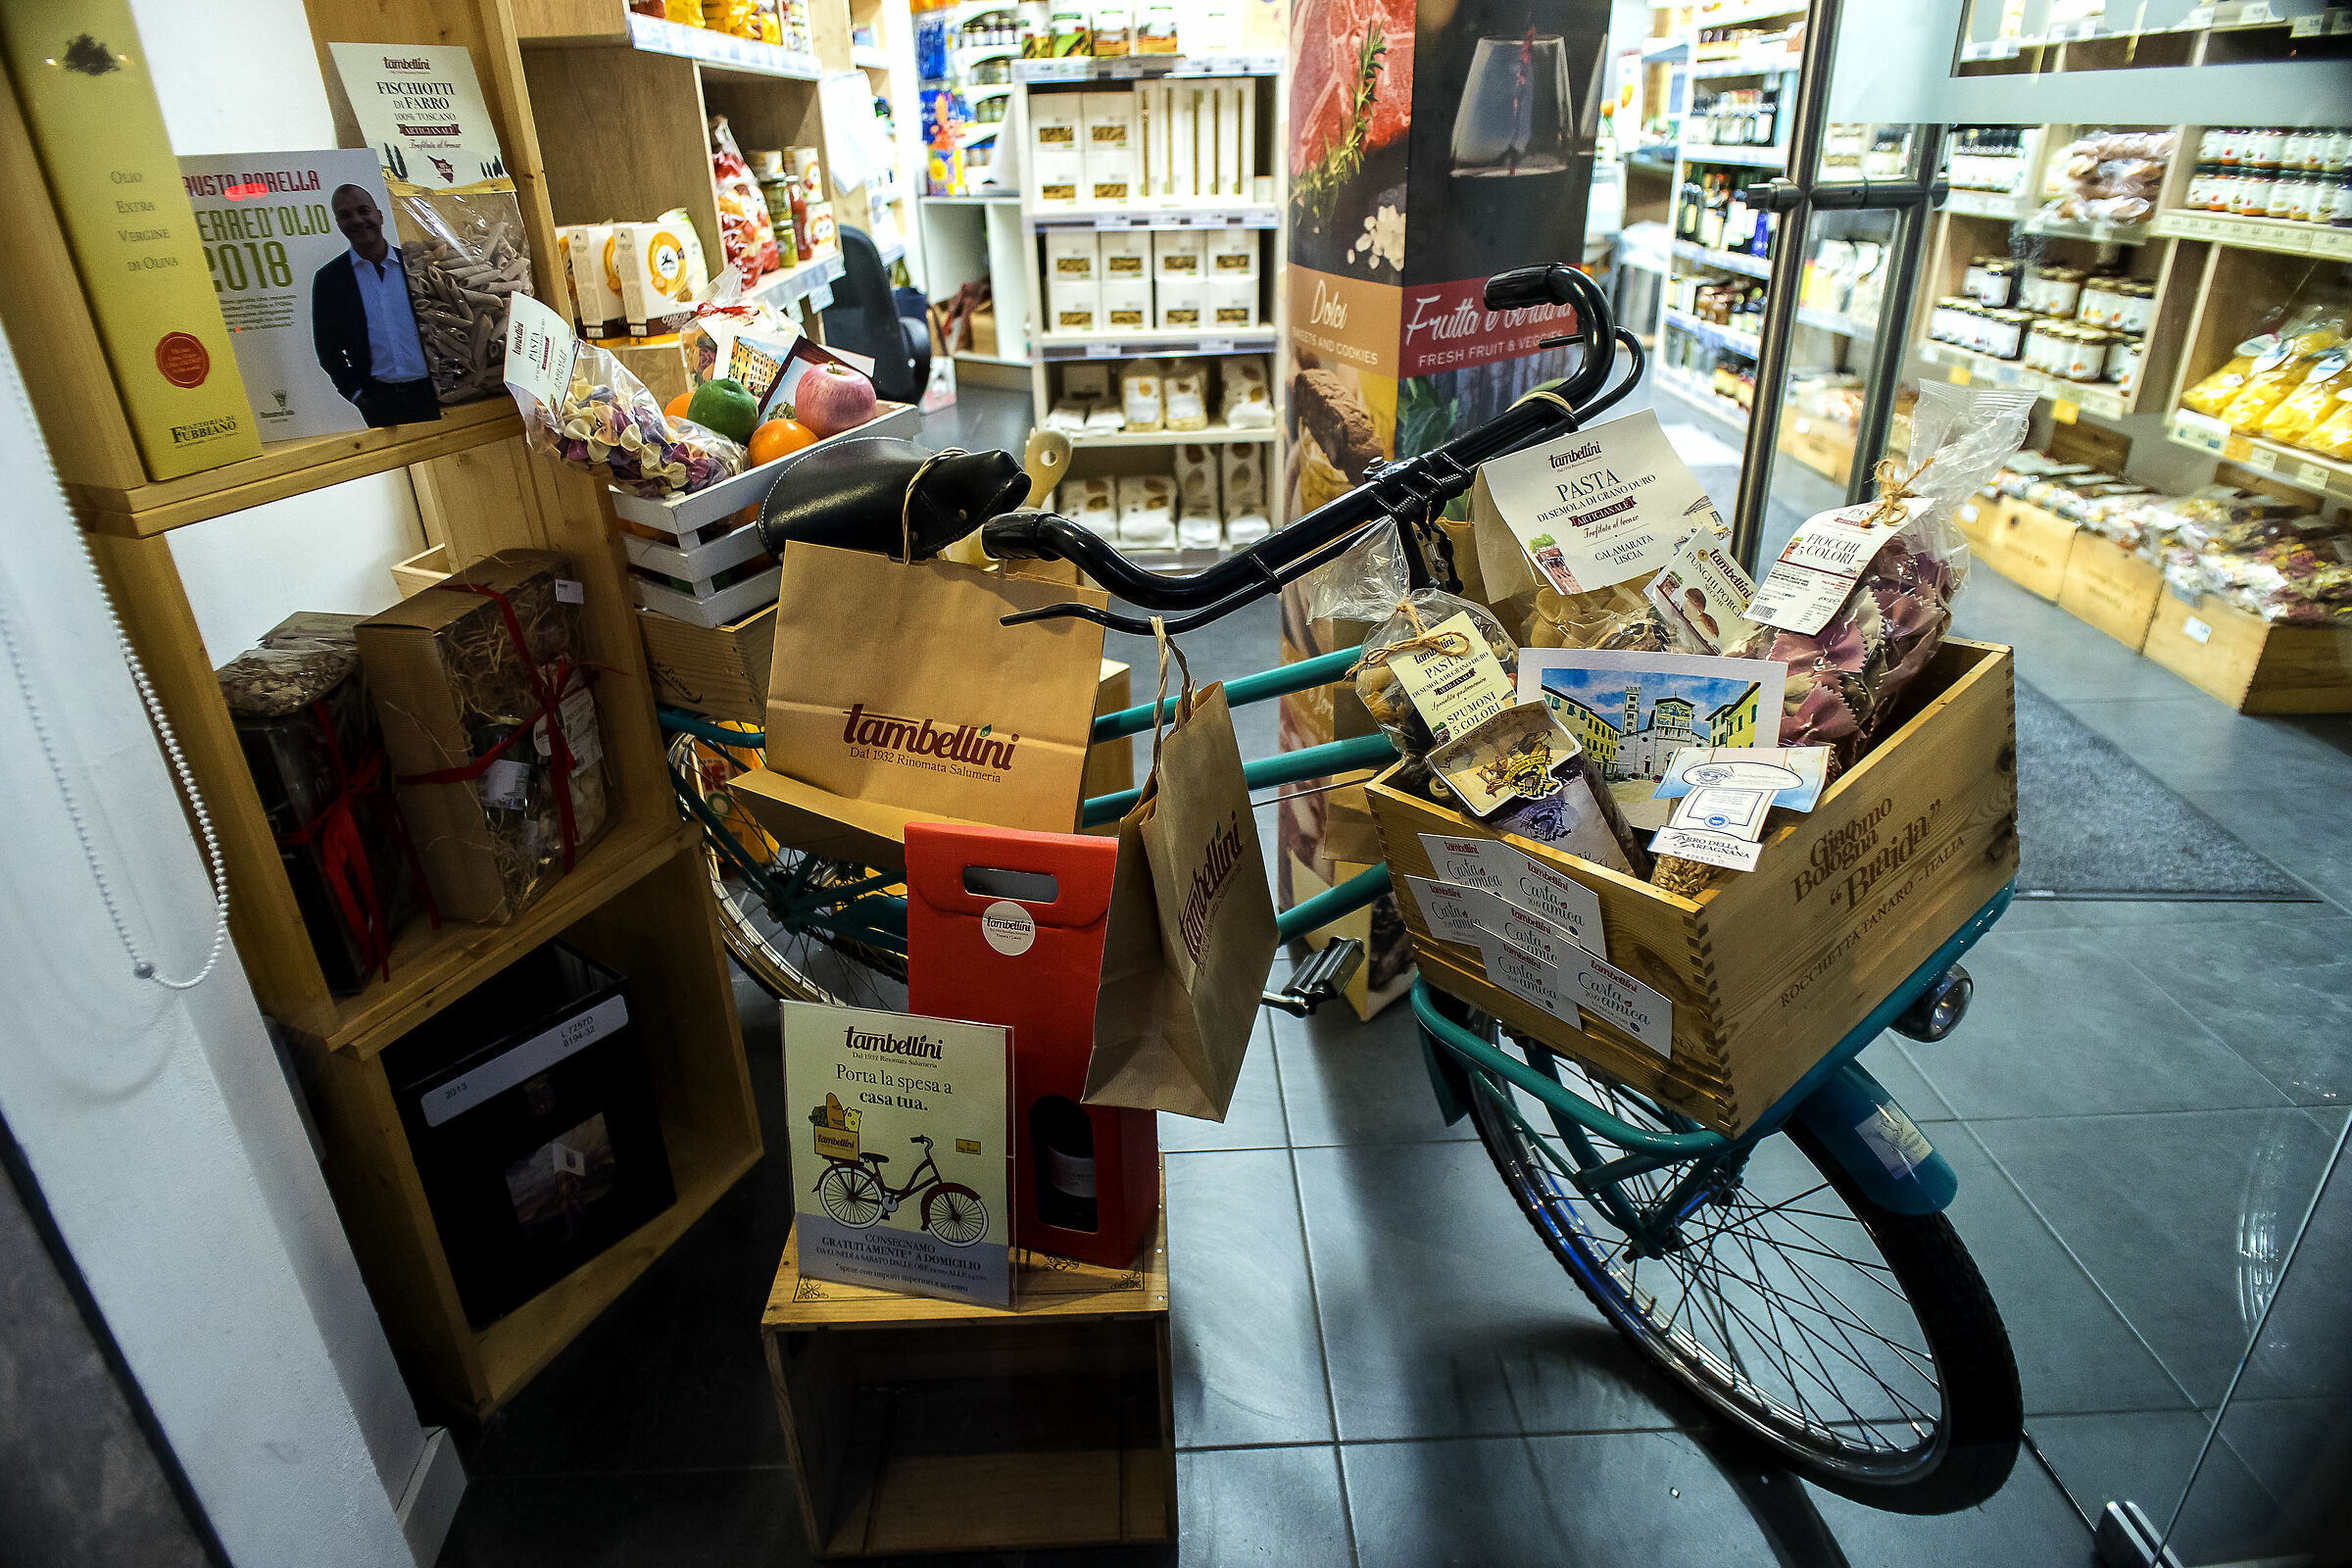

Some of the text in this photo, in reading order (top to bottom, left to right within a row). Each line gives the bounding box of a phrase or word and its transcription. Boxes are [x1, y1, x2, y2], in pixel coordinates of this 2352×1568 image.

[383, 57, 431, 70] tambellini
[376, 81, 456, 96] FISCHIOTTI
[393, 97, 450, 110] DI FARRO
[416, 113, 457, 122] TOSCANO
[1309, 279, 1348, 330] Dolci
[1406, 295, 1479, 346] Frutta
[1336, 343, 1379, 366] COOKIES
[1418, 350, 1464, 368] FRESH
[1469, 343, 1505, 361] FRUIT
[1548, 440, 1602, 468] tambellini
[1537, 474, 1656, 522] DI SEMOLA DI GRANO DURO
[1555, 468, 1622, 503] PASTA
[1577, 501, 1631, 526] ARTIGIANALE
[1594, 534, 1654, 562] CALAMARATA
[1796, 545, 1855, 564] 5 COLORI
[1806, 533, 1860, 554] FIOCCHI
[1614, 550, 1644, 565] LISCIA
[1709, 547, 1754, 600] tambellini
[1686, 552, 1719, 589] FUNGHI
[1717, 587, 1744, 621] PORCI
[1424, 655, 1464, 679] PASTA
[1446, 691, 1497, 724] SPUMONI
[1452, 725, 1460, 735] 5
[1460, 702, 1501, 731] COLORI
[842, 704, 1020, 770] tambellini
[850, 747, 1002, 783] Dal 1932 Rinomata Salumeria
[1444, 840, 1480, 855] tambellini
[1708, 841, 1740, 852] DELLA
[1446, 858, 1481, 880] Carta
[1527, 860, 1569, 892] tambellini
[1790, 829, 1880, 906] Bologna
[1178, 809, 1244, 967] tambellini
[1429, 884, 1462, 899] tambellini
[1519, 877, 1561, 906] Carta
[987, 915, 1032, 932] tambellini
[1432, 901, 1464, 921] Carta
[1511, 907, 1551, 935] tambellini
[1542, 901, 1585, 926] amica
[1504, 921, 1546, 951] Carta
[1779, 931, 1861, 1007] ROCCHETTA
[1862, 880, 1914, 934] TANARO
[1502, 943, 1541, 970] tambellini
[1527, 946, 1558, 964] amic
[1497, 956, 1536, 981] Carta
[1591, 959, 1638, 994] tambellini
[1519, 978, 1559, 1001] amica
[1578, 971, 1624, 1004] Carta
[1601, 996, 1650, 1025] amica
[844, 1025, 943, 1060] tambellini
[880, 1055, 907, 1064] Rinomata
[908, 1059, 938, 1068] Salumeria
[836, 1063, 953, 1094] Porta la spesa a
[859, 1092, 928, 1110] casa tua.
[817, 1134, 855, 1149] tambellini
[864, 1233, 936, 1252] CONSEGNAMO
[860, 1254, 889, 1265] SABATO
[890, 1258, 913, 1269] DALLE
[924, 1253, 981, 1271] DOMICILIO
